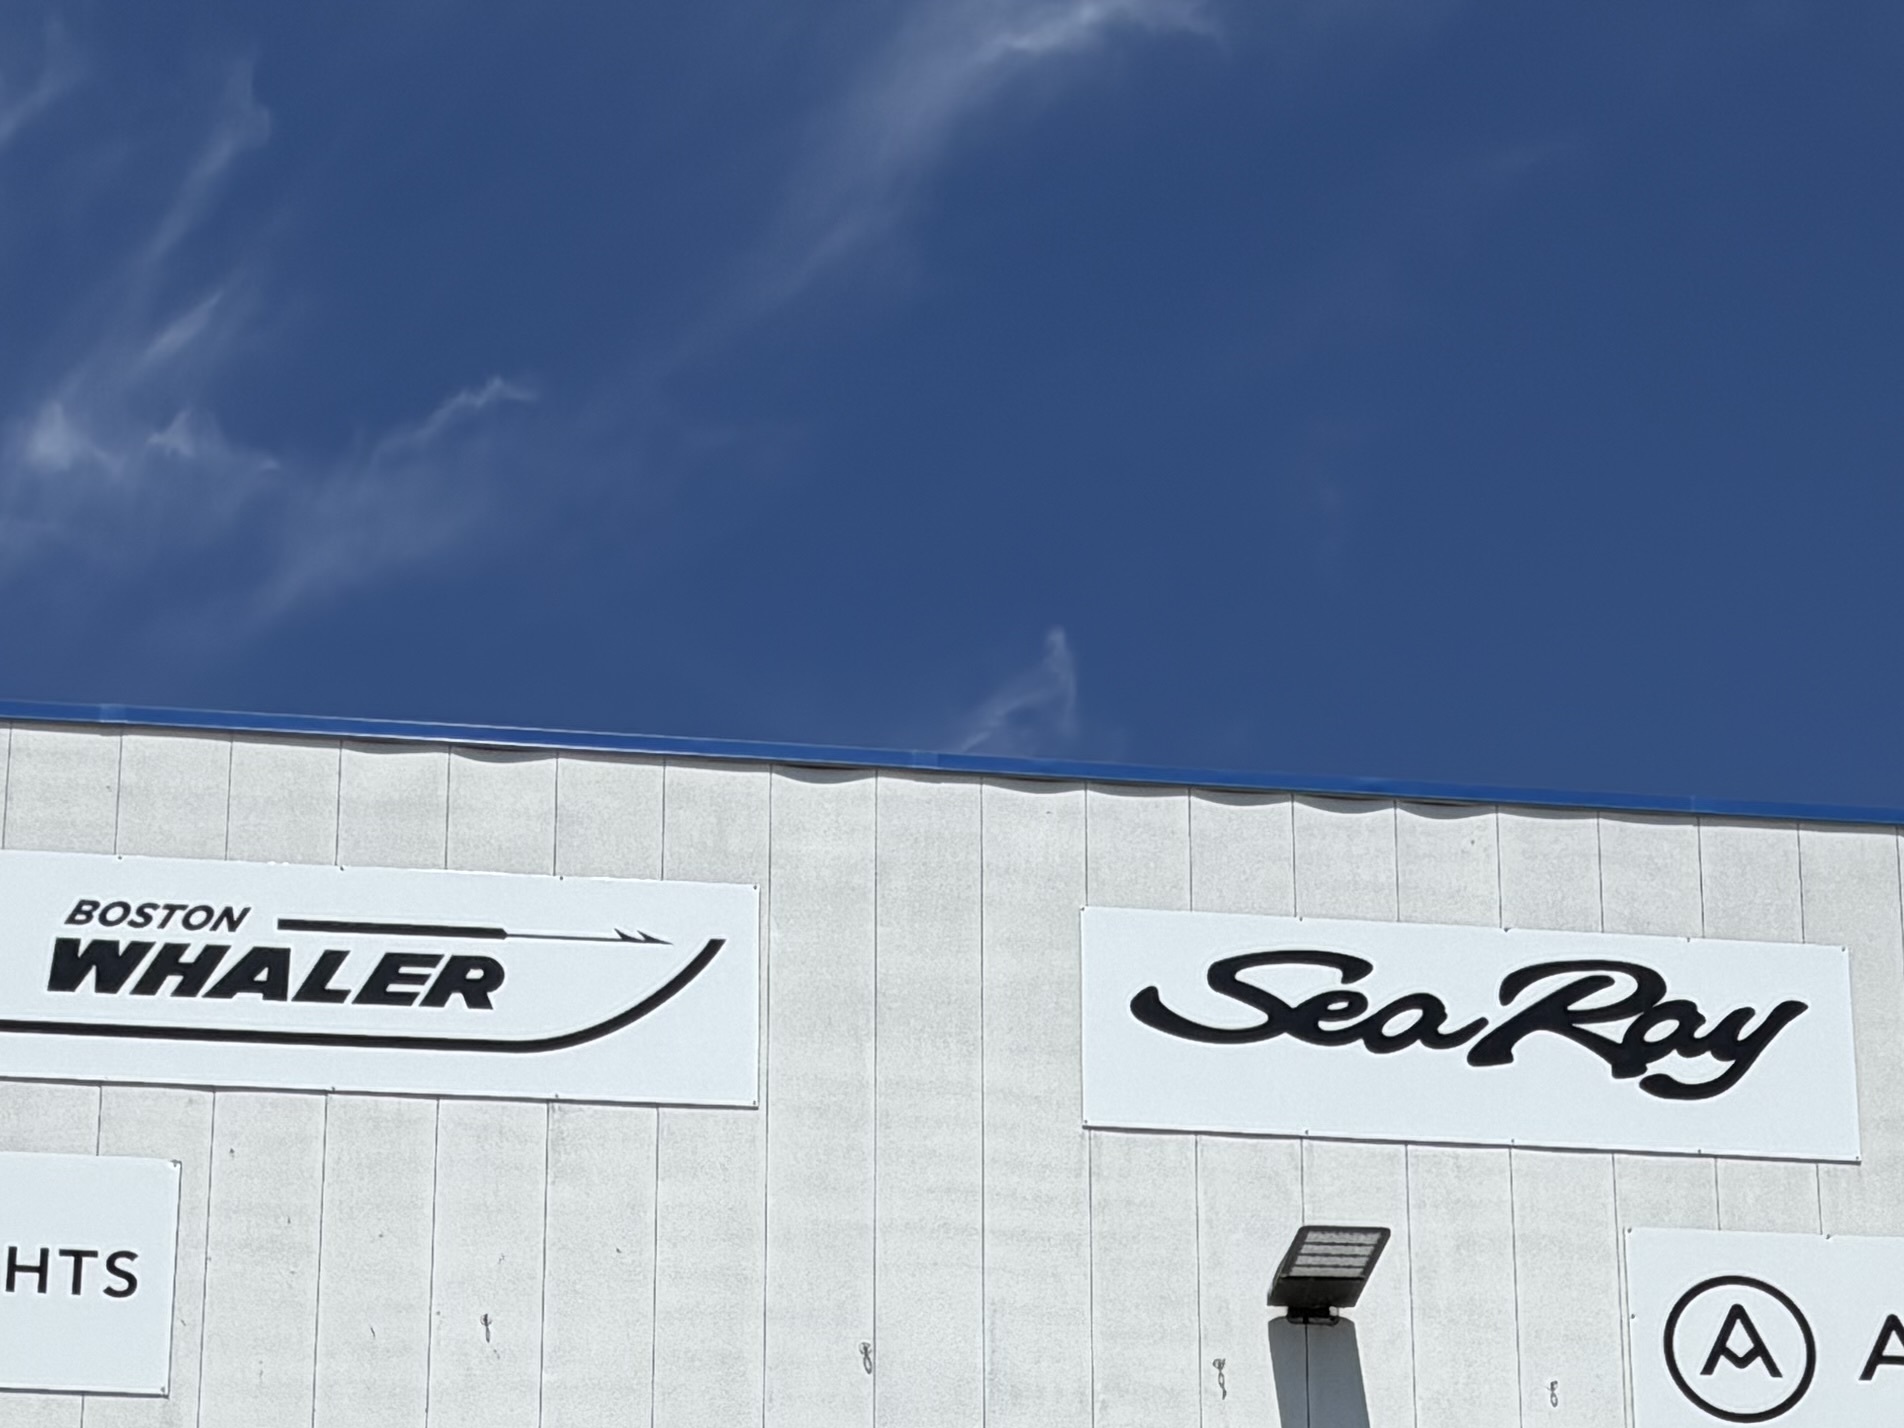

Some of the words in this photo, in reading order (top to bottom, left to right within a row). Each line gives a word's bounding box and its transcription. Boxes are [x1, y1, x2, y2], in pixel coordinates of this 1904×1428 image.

[65, 899, 251, 932] BOSTON
[47, 937, 505, 1010] WHALER
[1129, 949, 1489, 1054] Sea
[1466, 959, 1809, 1101] Ray
